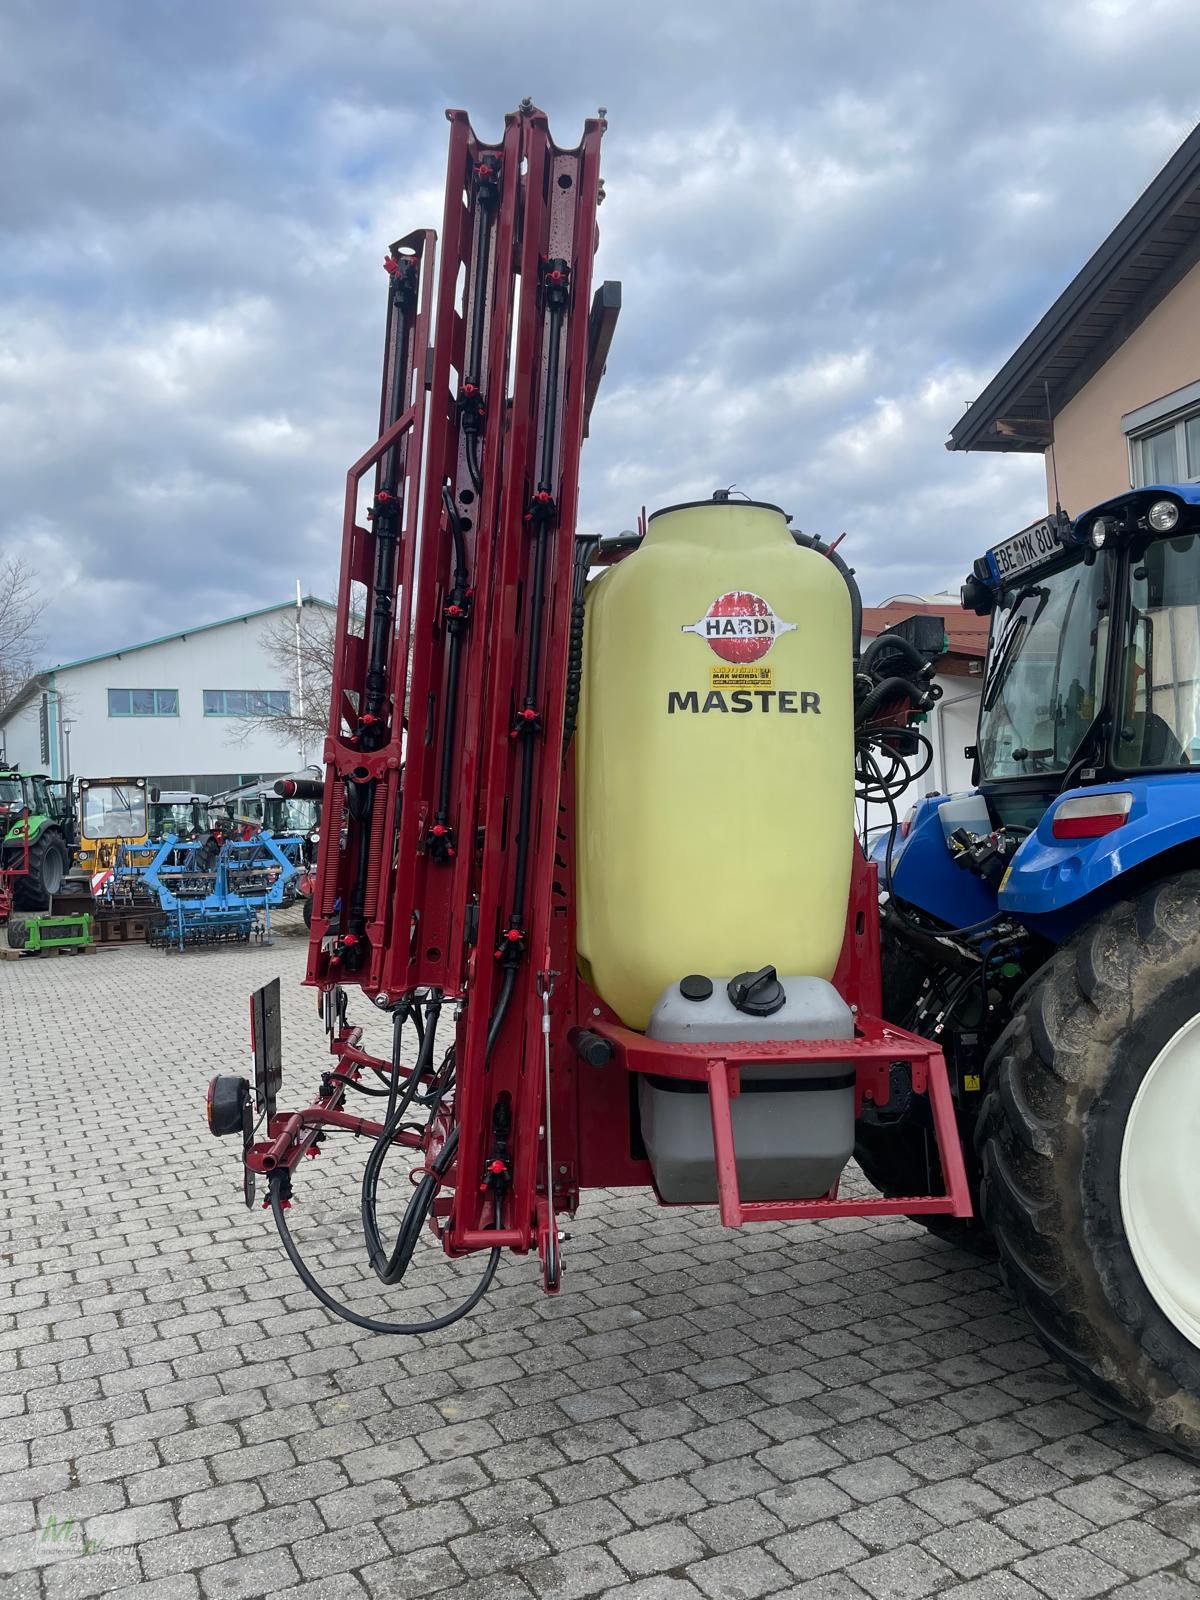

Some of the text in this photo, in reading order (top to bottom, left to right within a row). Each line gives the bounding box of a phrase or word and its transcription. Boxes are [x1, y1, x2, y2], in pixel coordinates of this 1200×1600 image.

[993, 545, 1017, 574] EBE
[1019, 533, 1037, 562] MK
[706, 619, 775, 635] HARDI
[668, 690, 821, 714] MASTER
